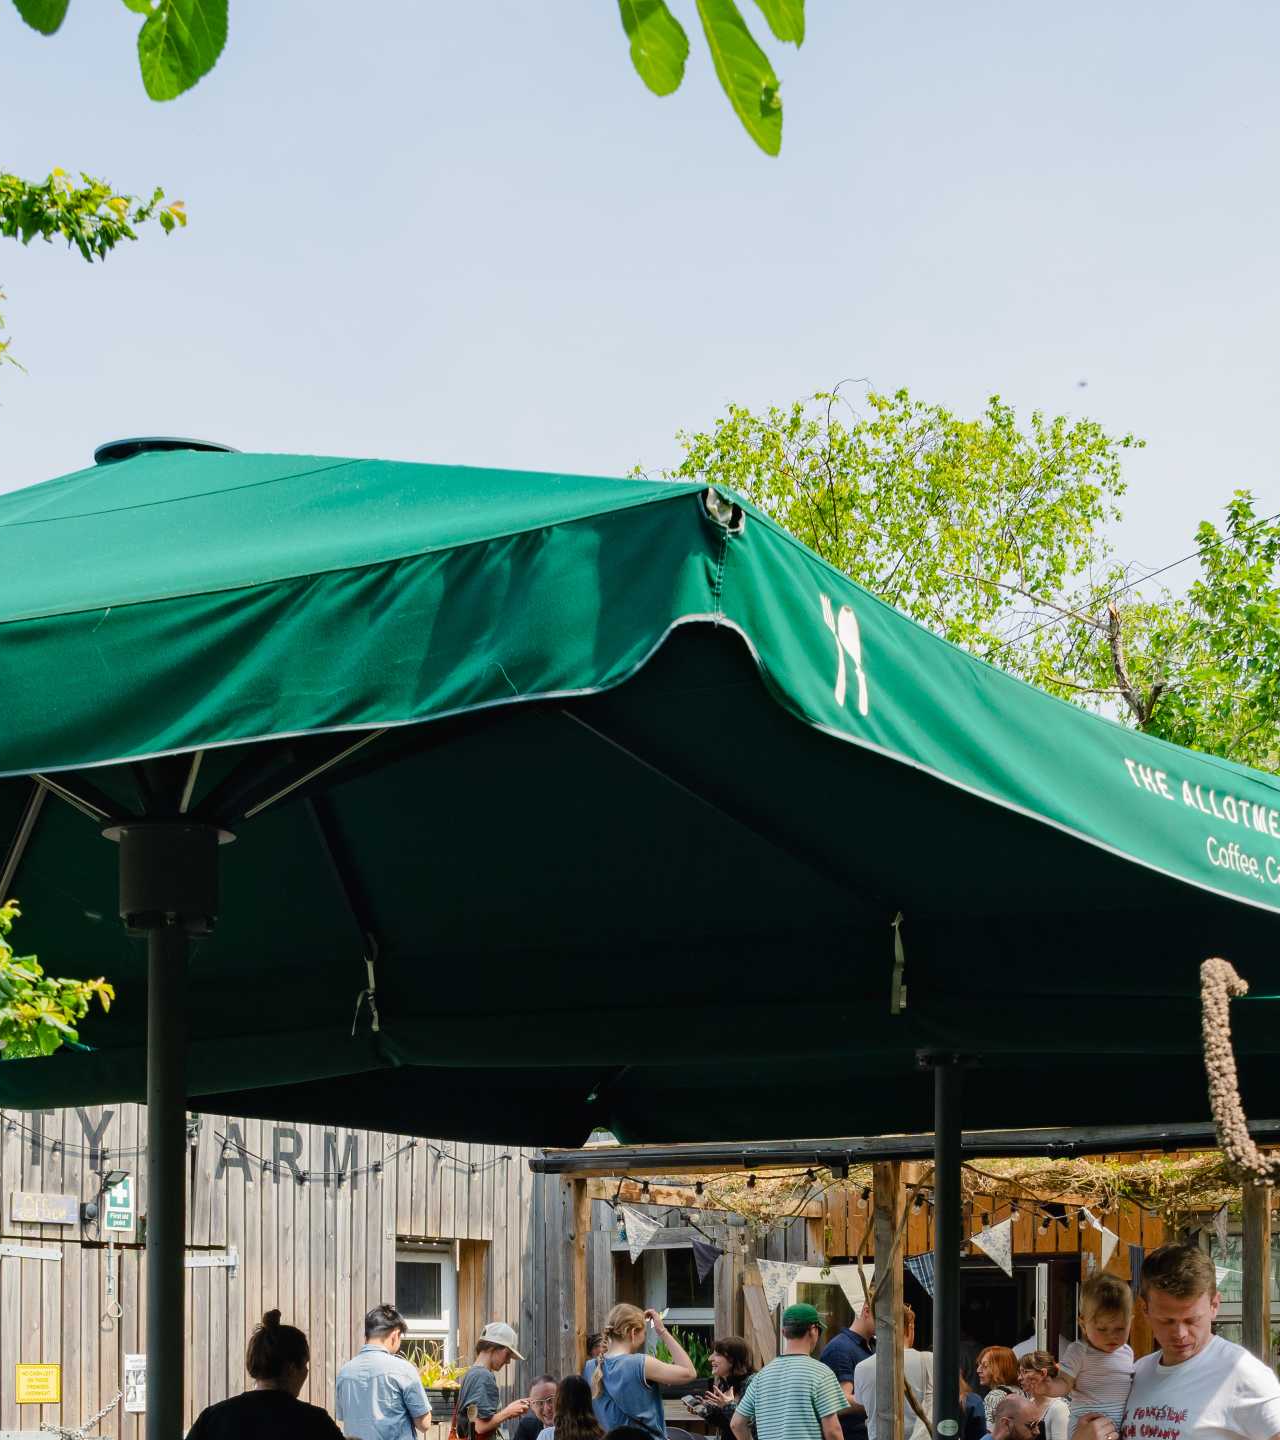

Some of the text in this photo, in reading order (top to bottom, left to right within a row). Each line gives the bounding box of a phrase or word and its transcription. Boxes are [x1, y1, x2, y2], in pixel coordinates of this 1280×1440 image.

[1124, 757, 1174, 801] THE
[1206, 835, 1265, 884] Coffee,
[214, 1122, 359, 1190] ARM
